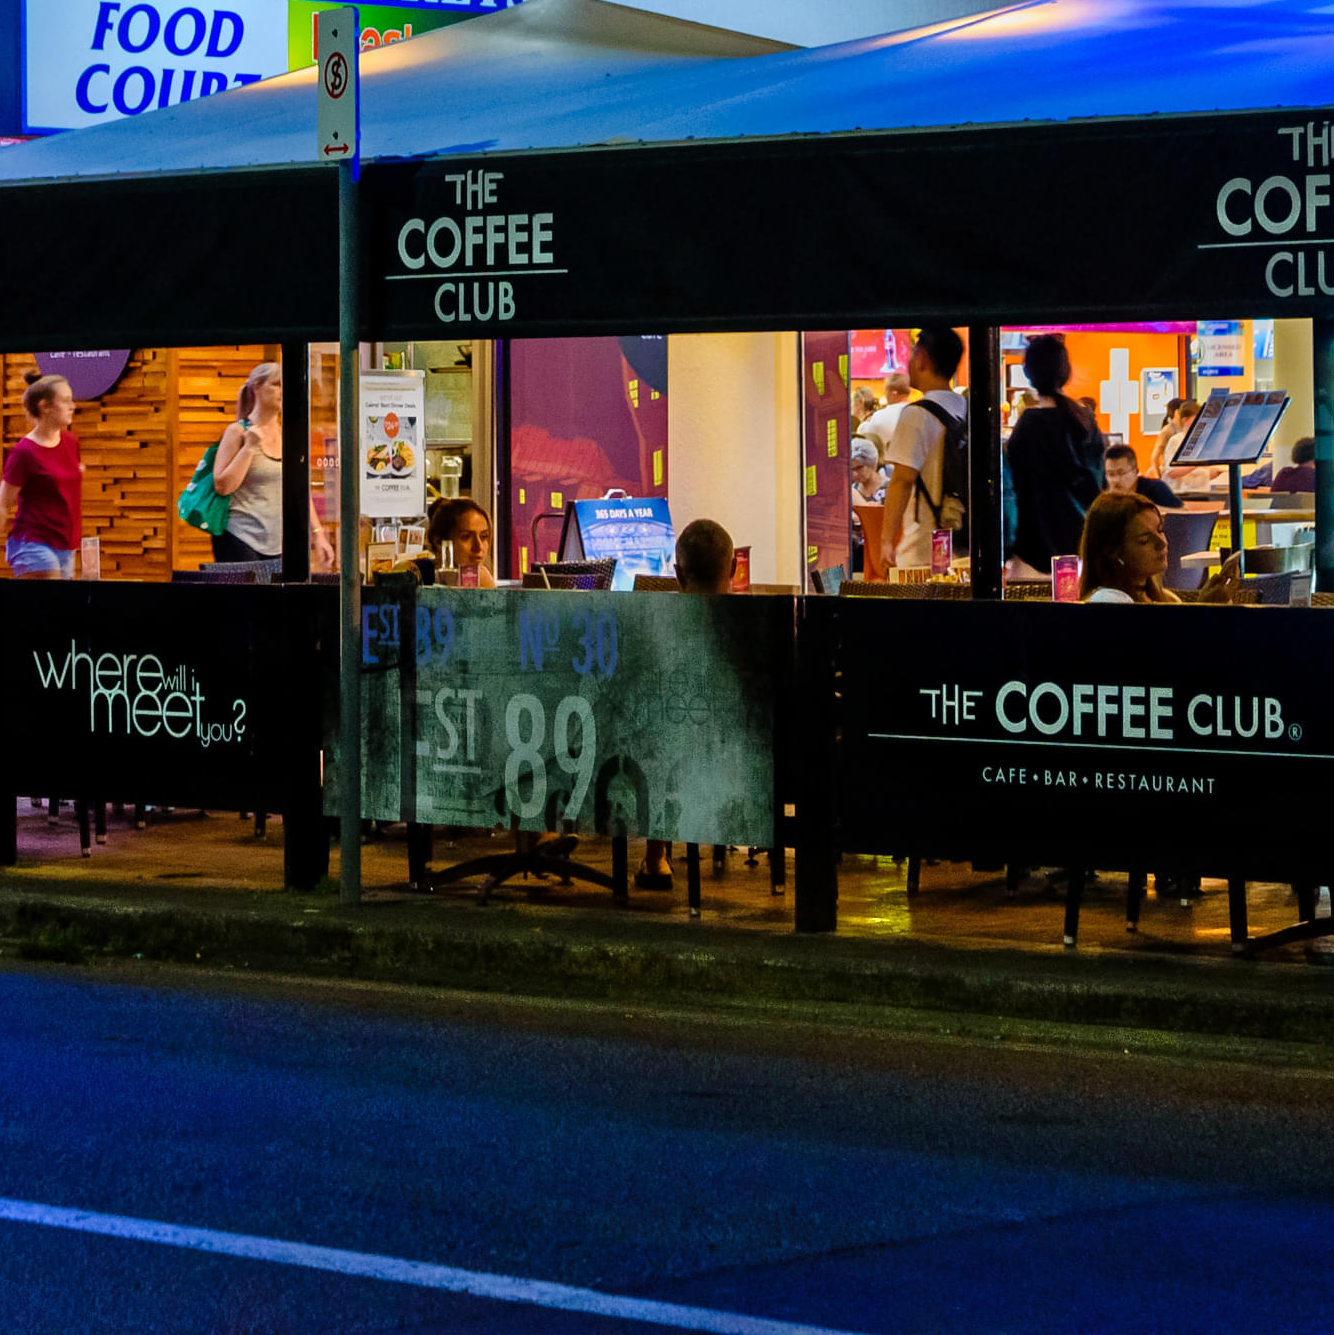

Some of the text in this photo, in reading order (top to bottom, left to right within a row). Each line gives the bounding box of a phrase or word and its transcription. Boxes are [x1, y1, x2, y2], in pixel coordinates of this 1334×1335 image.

[90, 1, 245, 58] FOOD
[74, 63, 261, 115] COU
[444, 169, 504, 210] THE
[397, 212, 554, 270] COFFEE
[433, 281, 516, 322] CLUB
[595, 507, 653, 519] 365 DAYS A YEAR
[32, 639, 163, 691] where
[161, 664, 187, 692] will
[573, 609, 619, 678] 30
[90, 682, 206, 738] meet
[919, 683, 983, 725] THE
[995, 680, 1174, 740] COFFEE
[503, 693, 597, 821] 89
